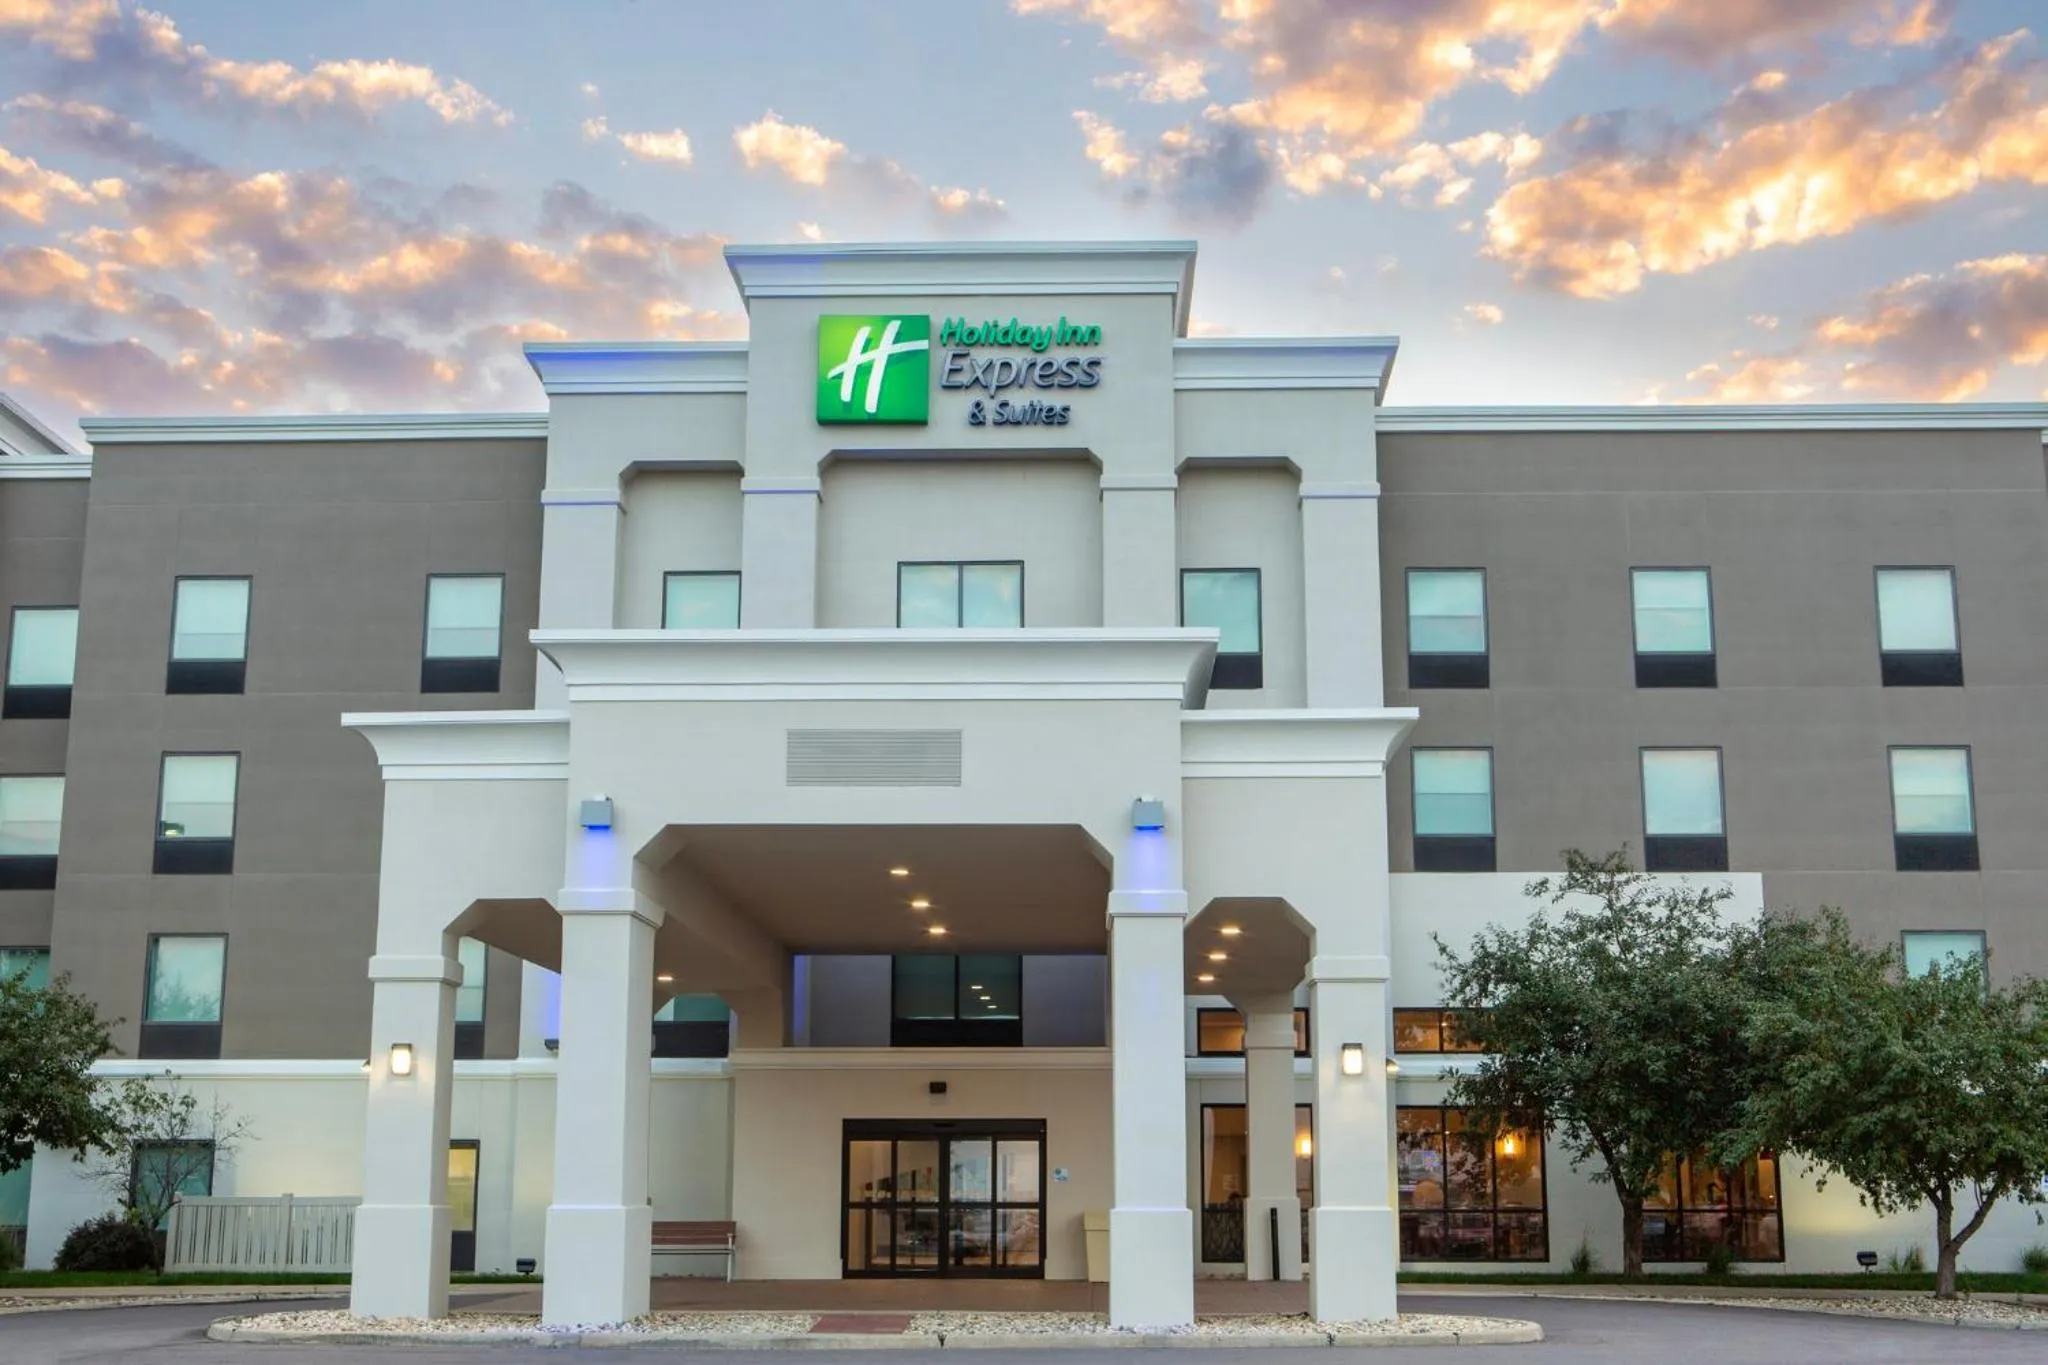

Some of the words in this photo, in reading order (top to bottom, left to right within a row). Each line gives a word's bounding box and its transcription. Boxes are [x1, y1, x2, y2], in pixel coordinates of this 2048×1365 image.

[940, 317, 1053, 353] Holiday
[1055, 316, 1102, 347] Inn
[941, 349, 1103, 399] Express
[967, 401, 986, 426] &
[993, 400, 1071, 426] Suites
